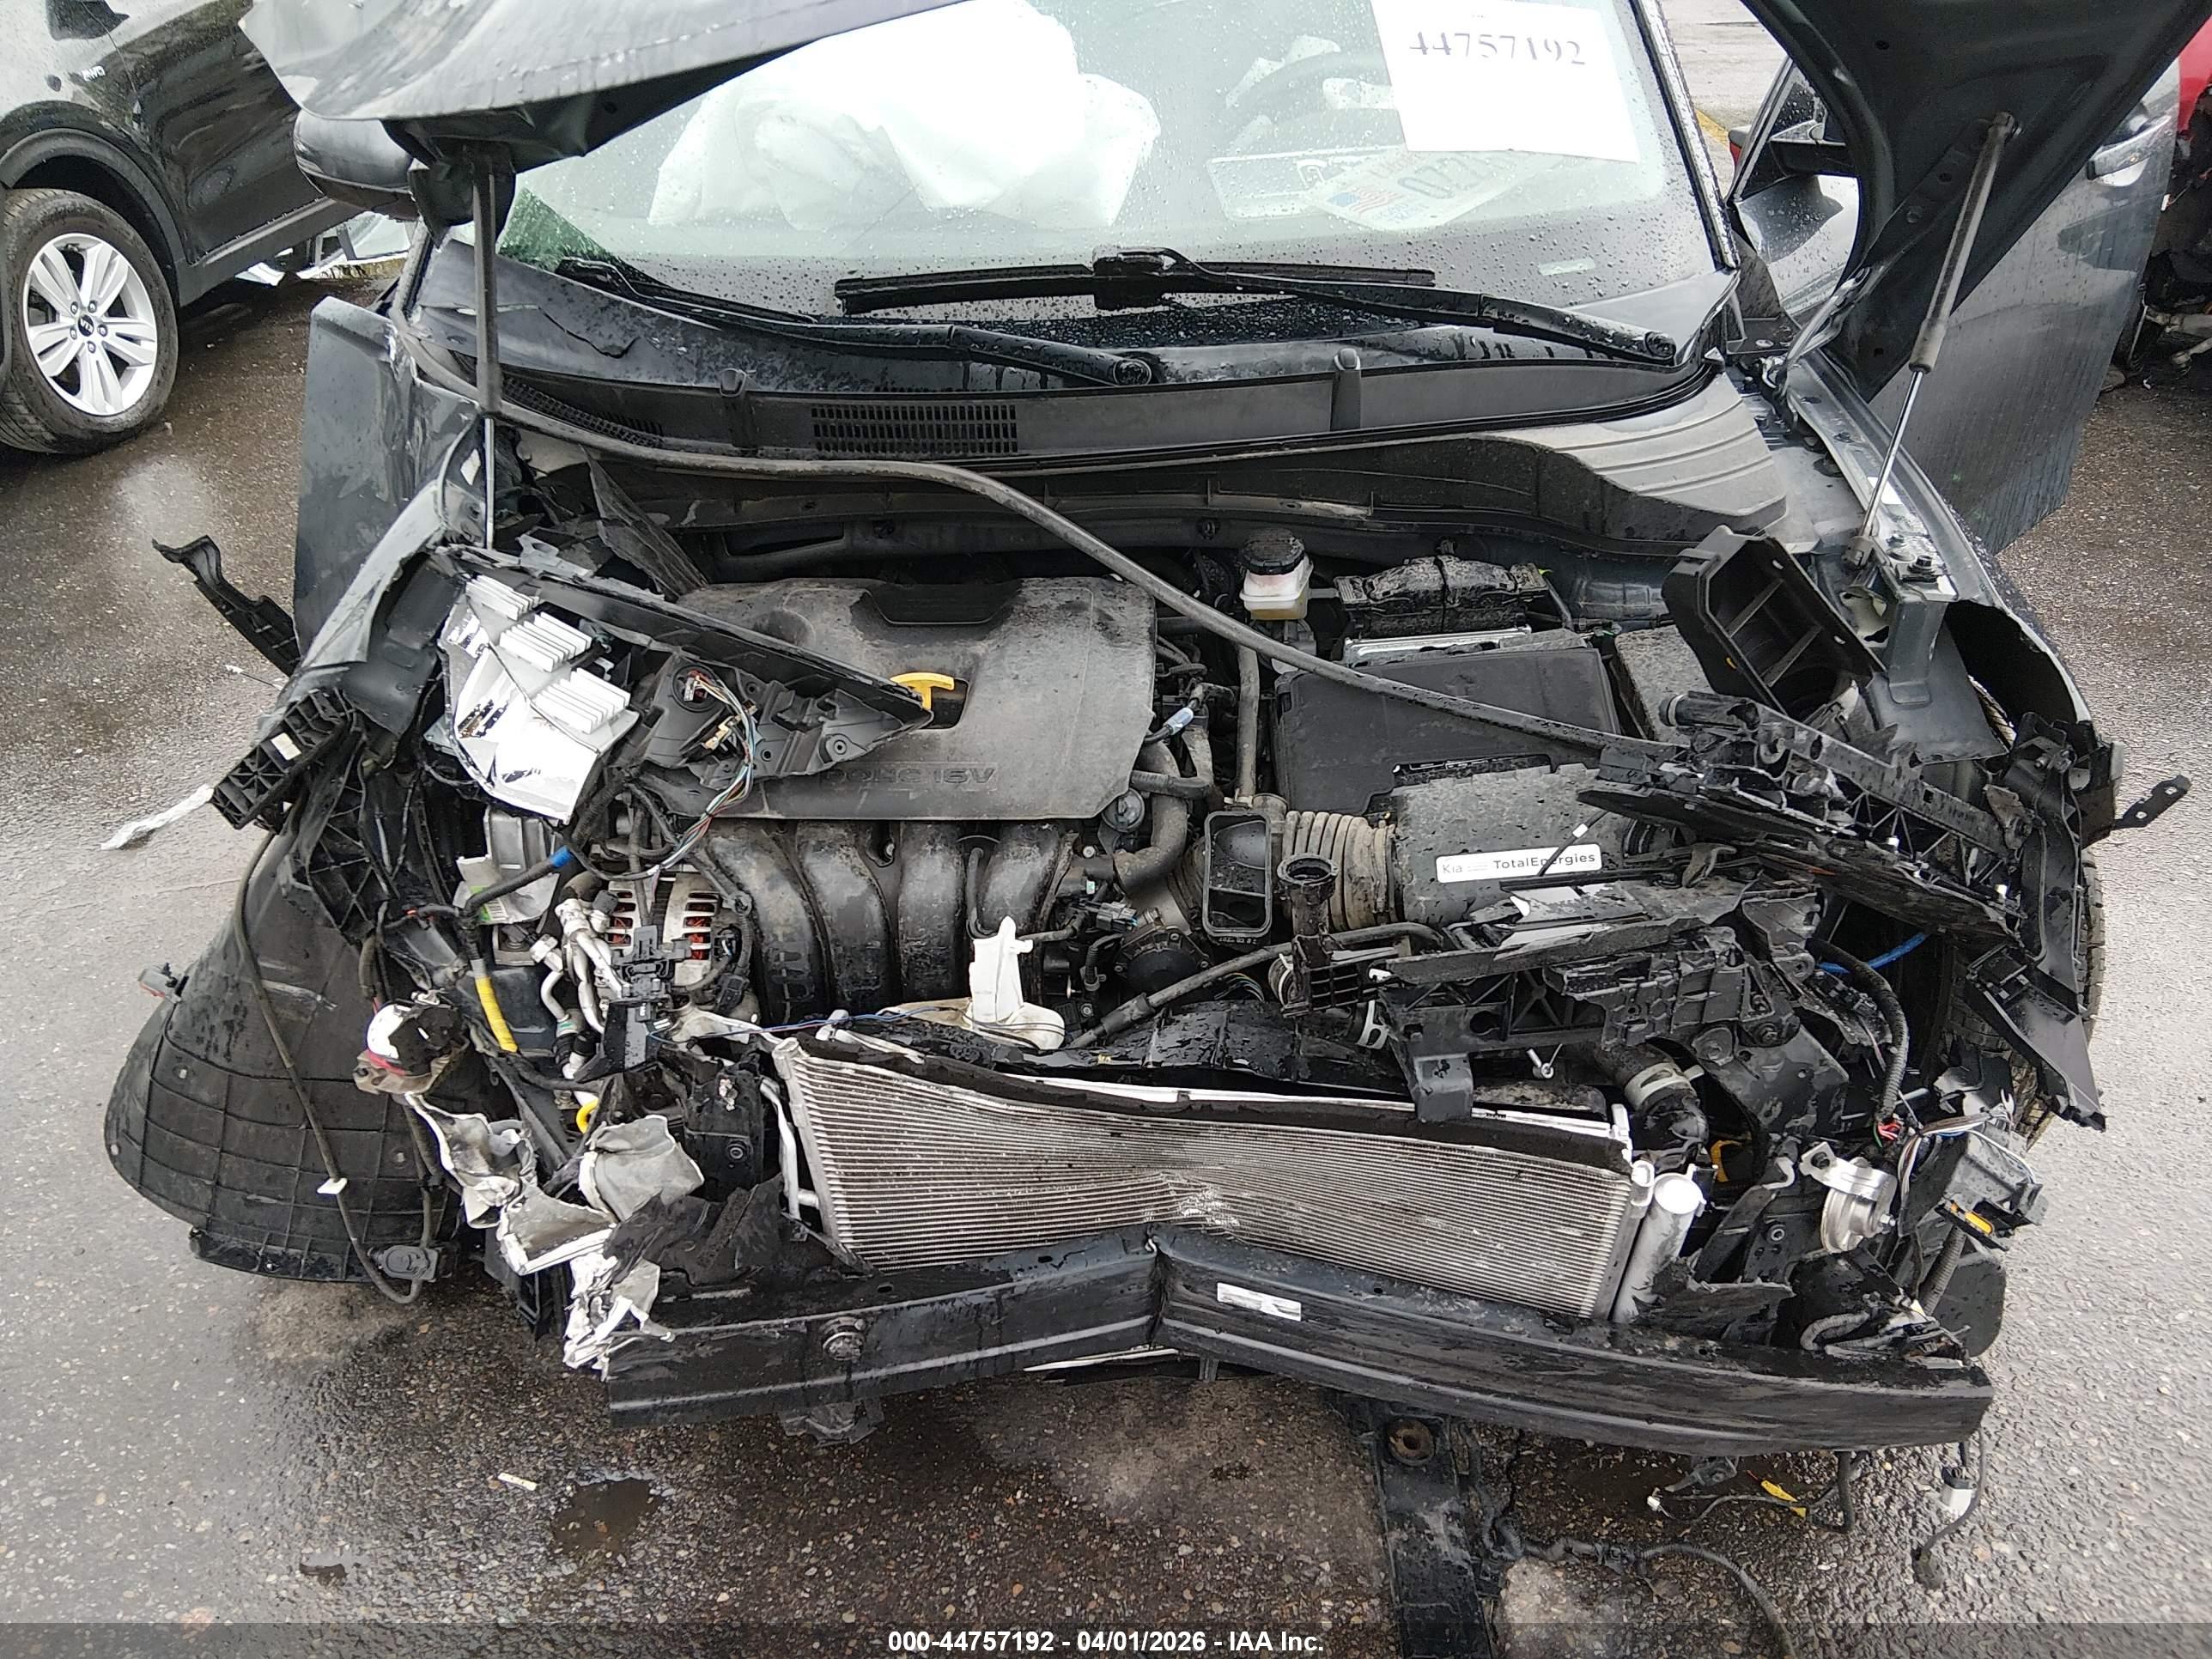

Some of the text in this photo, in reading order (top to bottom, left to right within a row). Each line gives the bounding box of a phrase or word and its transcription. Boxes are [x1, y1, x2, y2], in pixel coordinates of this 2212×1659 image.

[1409, 32, 1585, 65] 44757192
[933, 767, 997, 785] 16V
[1443, 862, 1462, 874] Kia
